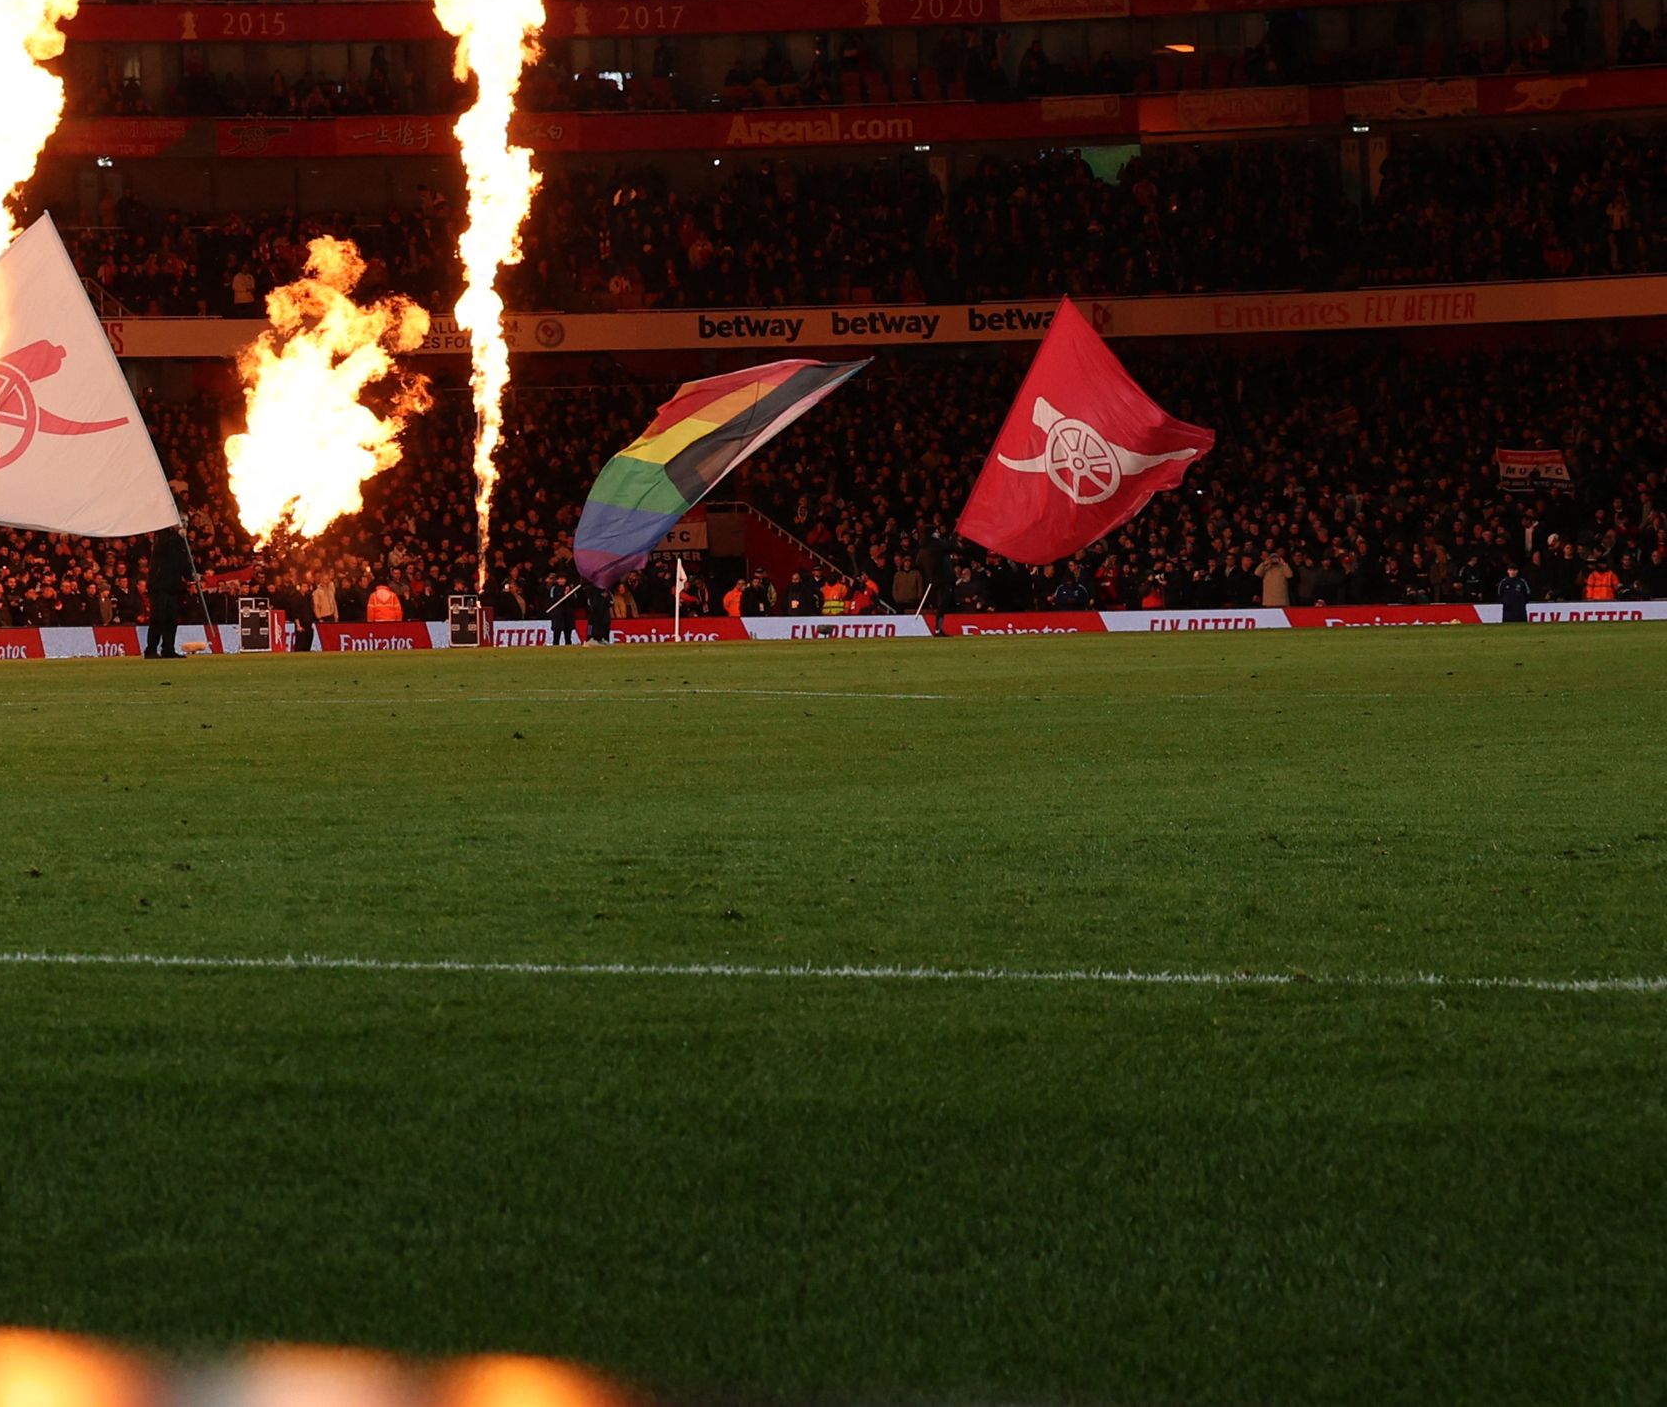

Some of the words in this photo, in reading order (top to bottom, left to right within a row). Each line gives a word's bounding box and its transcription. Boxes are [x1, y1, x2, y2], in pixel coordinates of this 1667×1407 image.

[222, 12, 286, 36] 2015
[617, 5, 684, 30] 2017
[726, 112, 913, 144] Arsenal.com
[1212, 299, 1350, 328] Emirates
[1364, 296, 1397, 323] FLY
[1403, 292, 1476, 321] BETTER
[699, 315, 803, 342] betway
[832, 312, 941, 339] betway
[969, 308, 1055, 332] betwa
[339, 633, 414, 652] Emirates
[495, 629, 546, 646] ETTER
